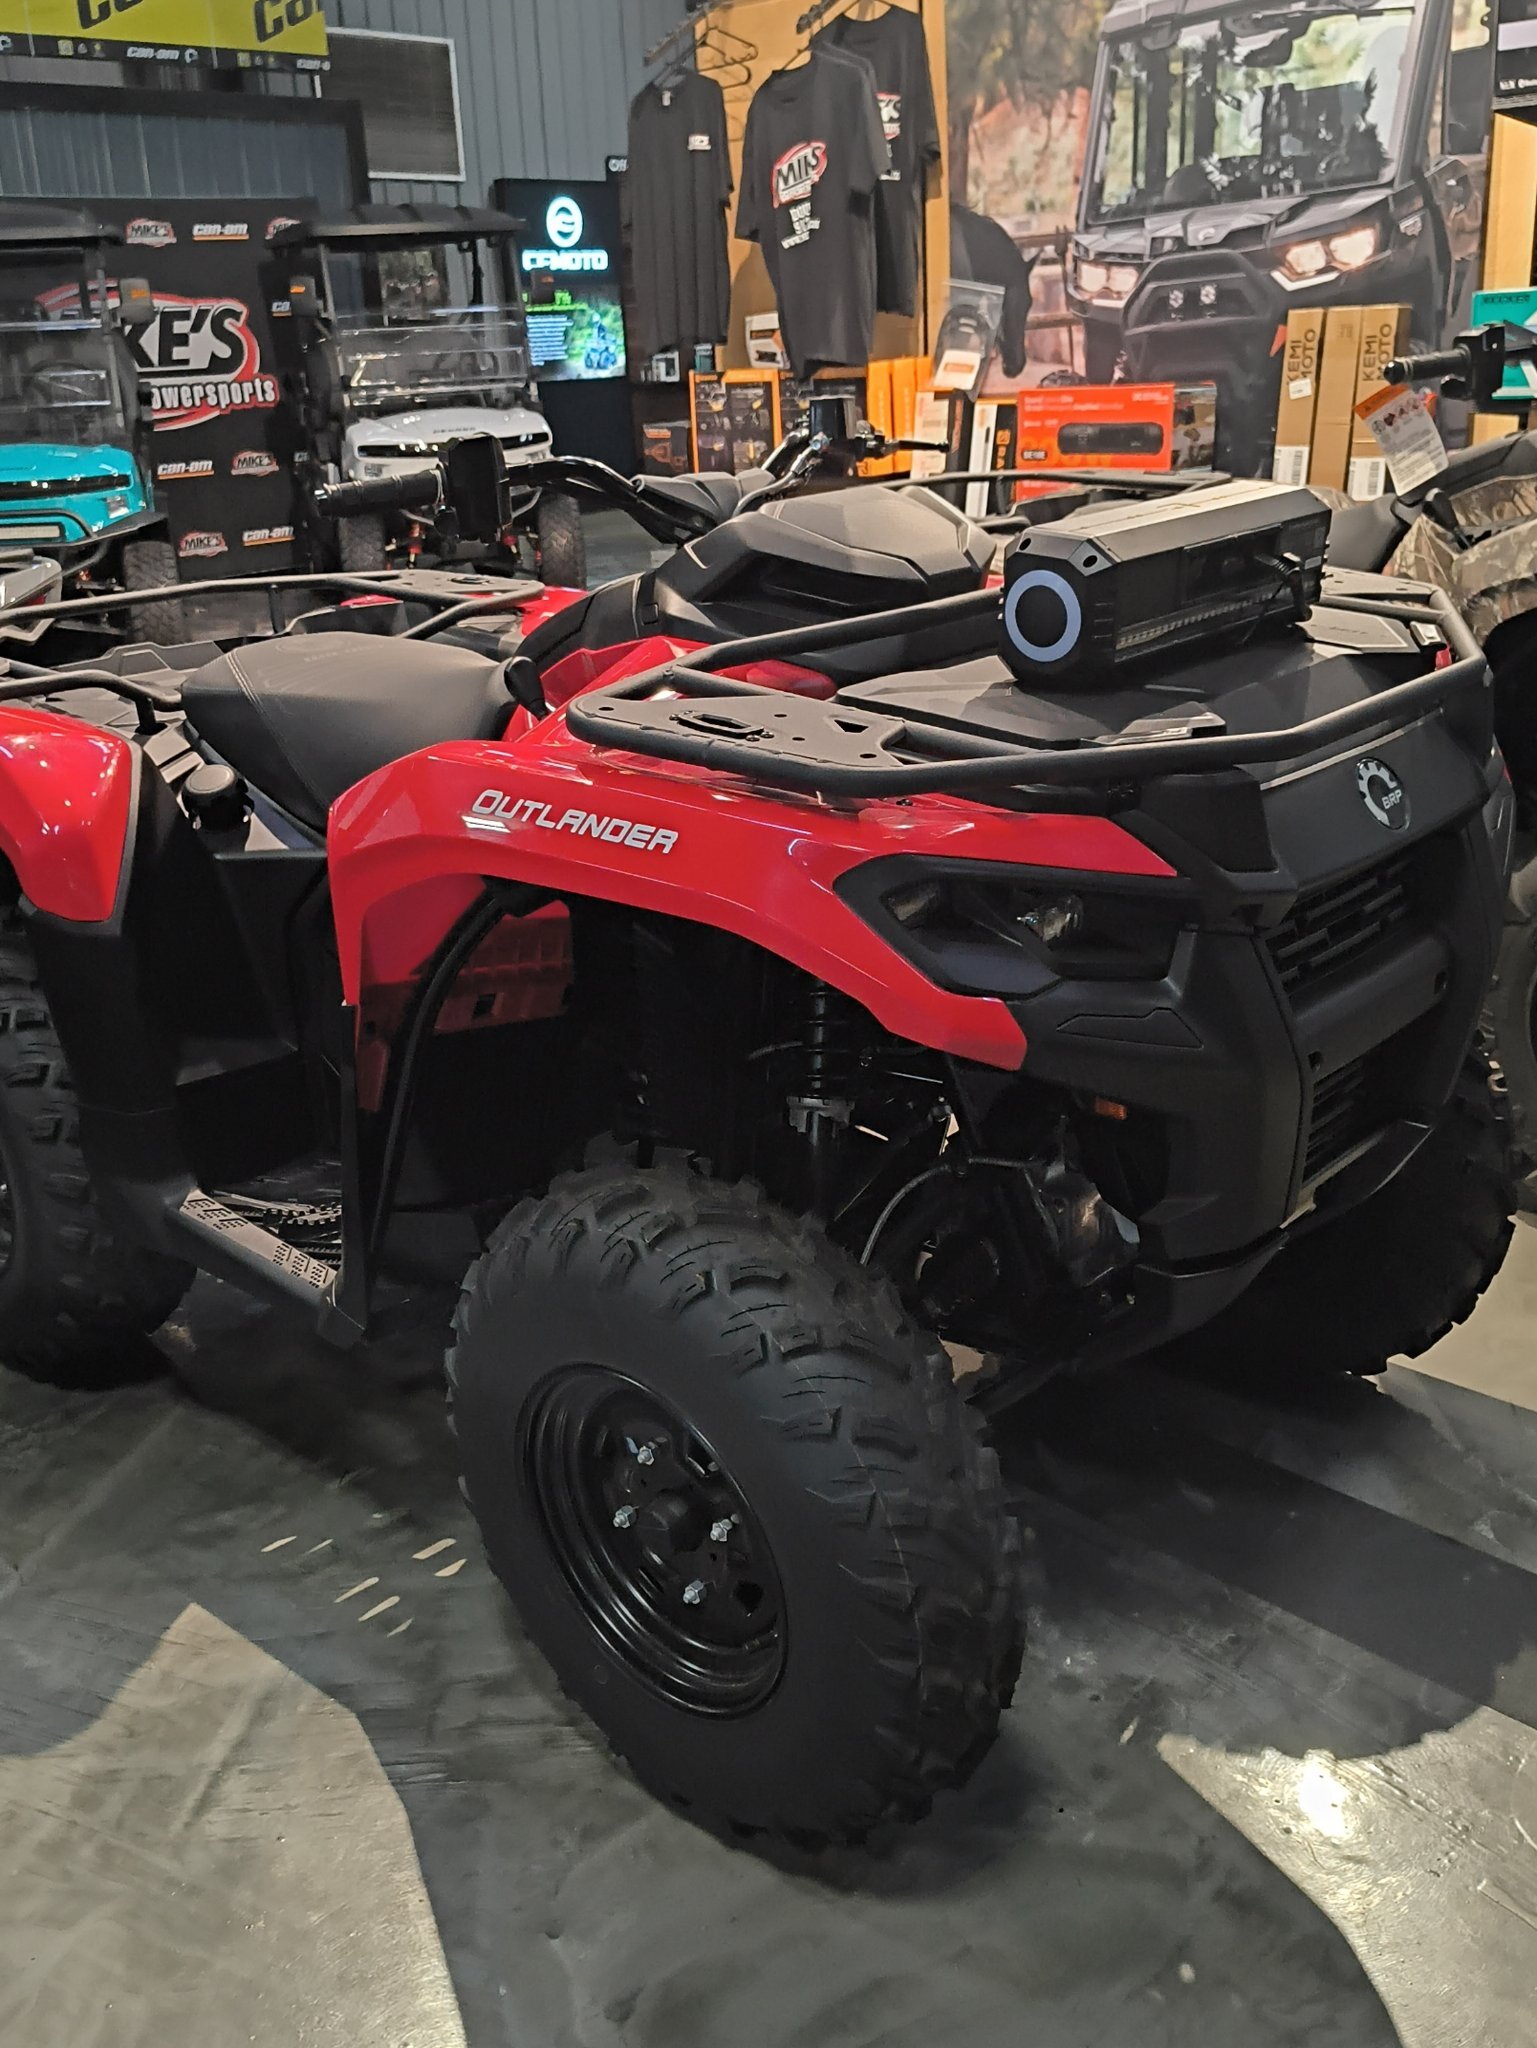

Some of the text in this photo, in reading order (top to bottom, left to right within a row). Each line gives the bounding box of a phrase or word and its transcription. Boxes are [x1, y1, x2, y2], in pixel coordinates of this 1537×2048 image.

[192, 223, 249, 236] can-am
[522, 249, 609, 271] CFMOTO
[1362, 335, 1380, 381] KEMI
[151, 377, 276, 410] owersports
[157, 460, 213, 476] can-am
[237, 455, 273, 468] MIKE'S
[184, 534, 222, 550] MIKE'S
[242, 526, 294, 541] can-am
[1381, 789, 1402, 809] BRP
[471, 789, 679, 854] OUTLANDER
